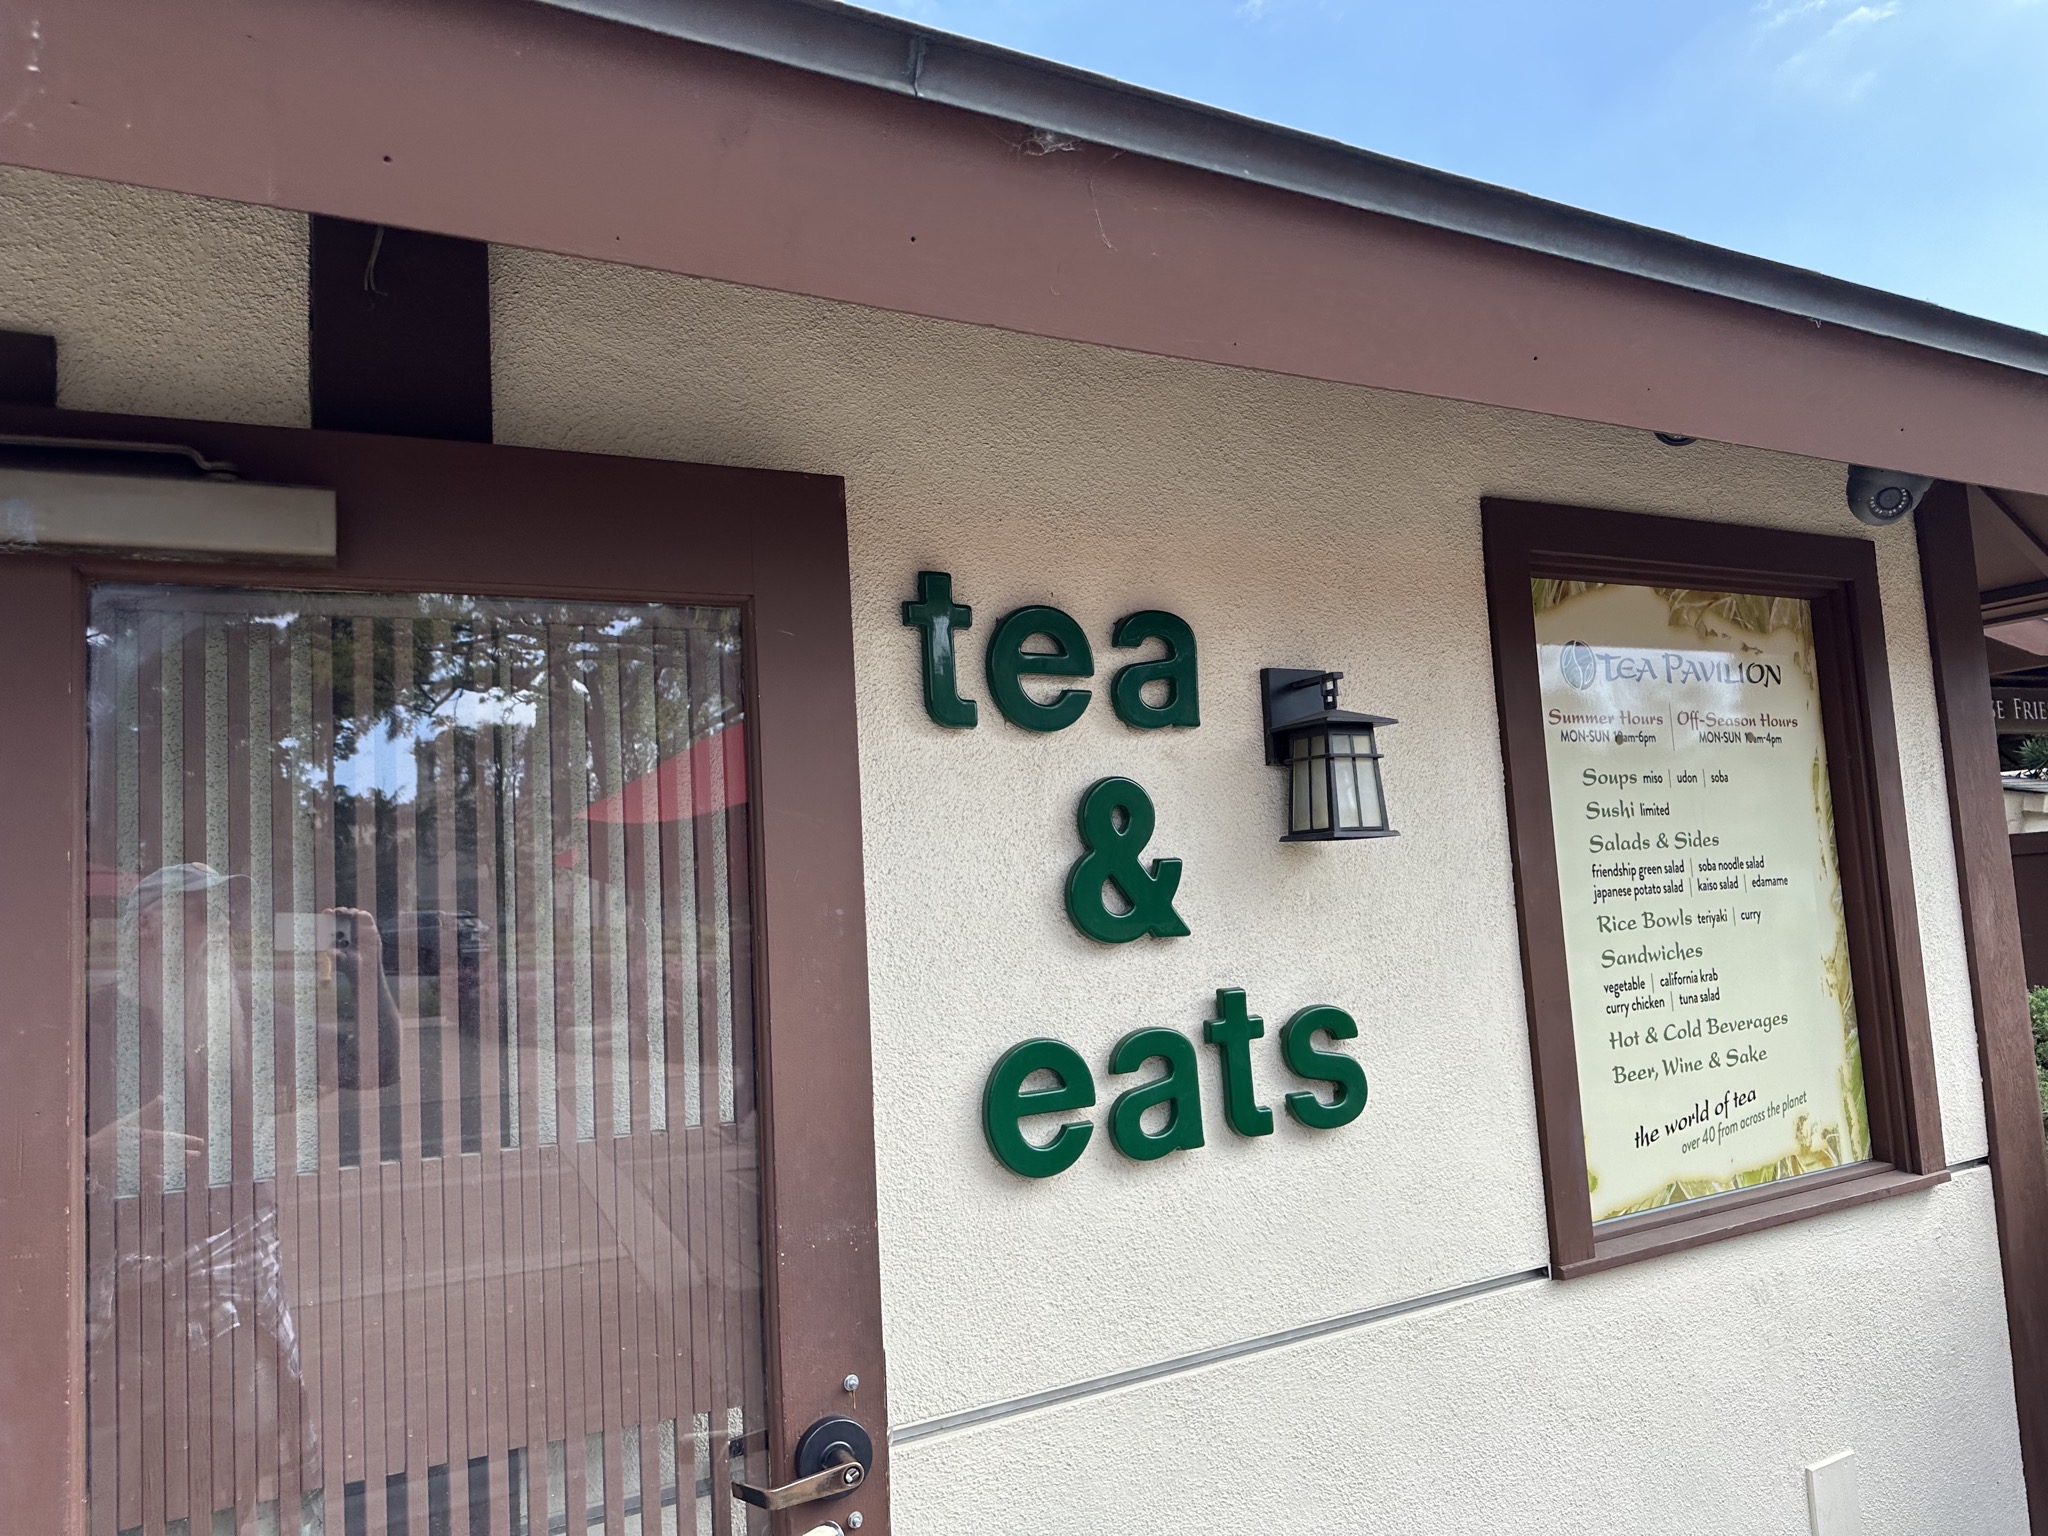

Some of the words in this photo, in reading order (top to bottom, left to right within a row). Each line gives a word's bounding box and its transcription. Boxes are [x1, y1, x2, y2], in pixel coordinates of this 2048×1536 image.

[902, 570, 1201, 732] tea
[1596, 653, 1658, 682] TEA
[1661, 652, 1781, 688] PAVILION
[1548, 708, 1615, 726] Summer
[1619, 710, 1664, 726] Hours
[1677, 710, 1756, 731] Off-Season
[1760, 713, 1798, 728] Hours
[2013, 697, 2048, 720] FRIE
[1560, 729, 1610, 743] MON-SUN
[1699, 731, 1742, 744] MON-SUN
[1582, 768, 1638, 790] Soups
[1642, 770, 1663, 784] miso
[1676, 769, 1698, 784] udon
[1710, 769, 1729, 783] soba
[1585, 799, 1635, 820] Sushi
[1639, 802, 1670, 817] limited
[1588, 831, 1651, 854] Salads
[1656, 832, 1670, 849] &
[1674, 829, 1720, 850] Sides
[1065, 776, 1192, 945] &
[1591, 862, 1637, 881] friendship
[1638, 865, 1663, 881] green
[1664, 858, 1685, 874] salad
[1698, 857, 1717, 872] soba
[1718, 855, 1745, 871] noodle
[1745, 855, 1765, 869] salad
[1592, 884, 1632, 905] japanese
[1633, 883, 1662, 902] potato
[1663, 878, 1684, 894] salad
[1697, 877, 1718, 892] kaiso
[1719, 875, 1739, 890] salad
[1751, 874, 1789, 888] edamame
[1596, 915, 1638, 934] Rice
[1641, 908, 1693, 929] Bowls
[1697, 908, 1728, 929] teriyaki
[1740, 909, 1762, 925] curry
[1601, 941, 1704, 969] Sandwiches
[1603, 975, 1646, 999] vegetable
[1659, 970, 1699, 987] california
[1699, 967, 1719, 983] krab
[1605, 1002, 1630, 1018] curry
[1631, 994, 1666, 1012] chicken
[1679, 993, 1699, 1006] tuna
[1699, 986, 1721, 1003] salad
[1609, 1031, 1640, 1049] Hot
[1645, 1026, 1659, 1044] &
[1663, 1018, 1702, 1042] Cold
[1706, 1012, 1789, 1035] Beverages
[1612, 1065, 1659, 1084] Beer,
[1661, 1056, 1704, 1077] Wine
[1708, 1051, 1722, 1069] &
[1726, 1044, 1769, 1068] Sake
[982, 986, 1368, 1178] eats
[1634, 1125, 1661, 1149] the
[1664, 1099, 1710, 1137] world
[1714, 1090, 1731, 1119] of
[1732, 1089, 1757, 1109] tea
[1681, 1136, 1702, 1154] over
[1702, 1125, 1716, 1145] 40
[1717, 1121, 1739, 1146] from
[1740, 1110, 1766, 1130] across
[1766, 1100, 1781, 1119] the
[1782, 1091, 1808, 1119] planet
